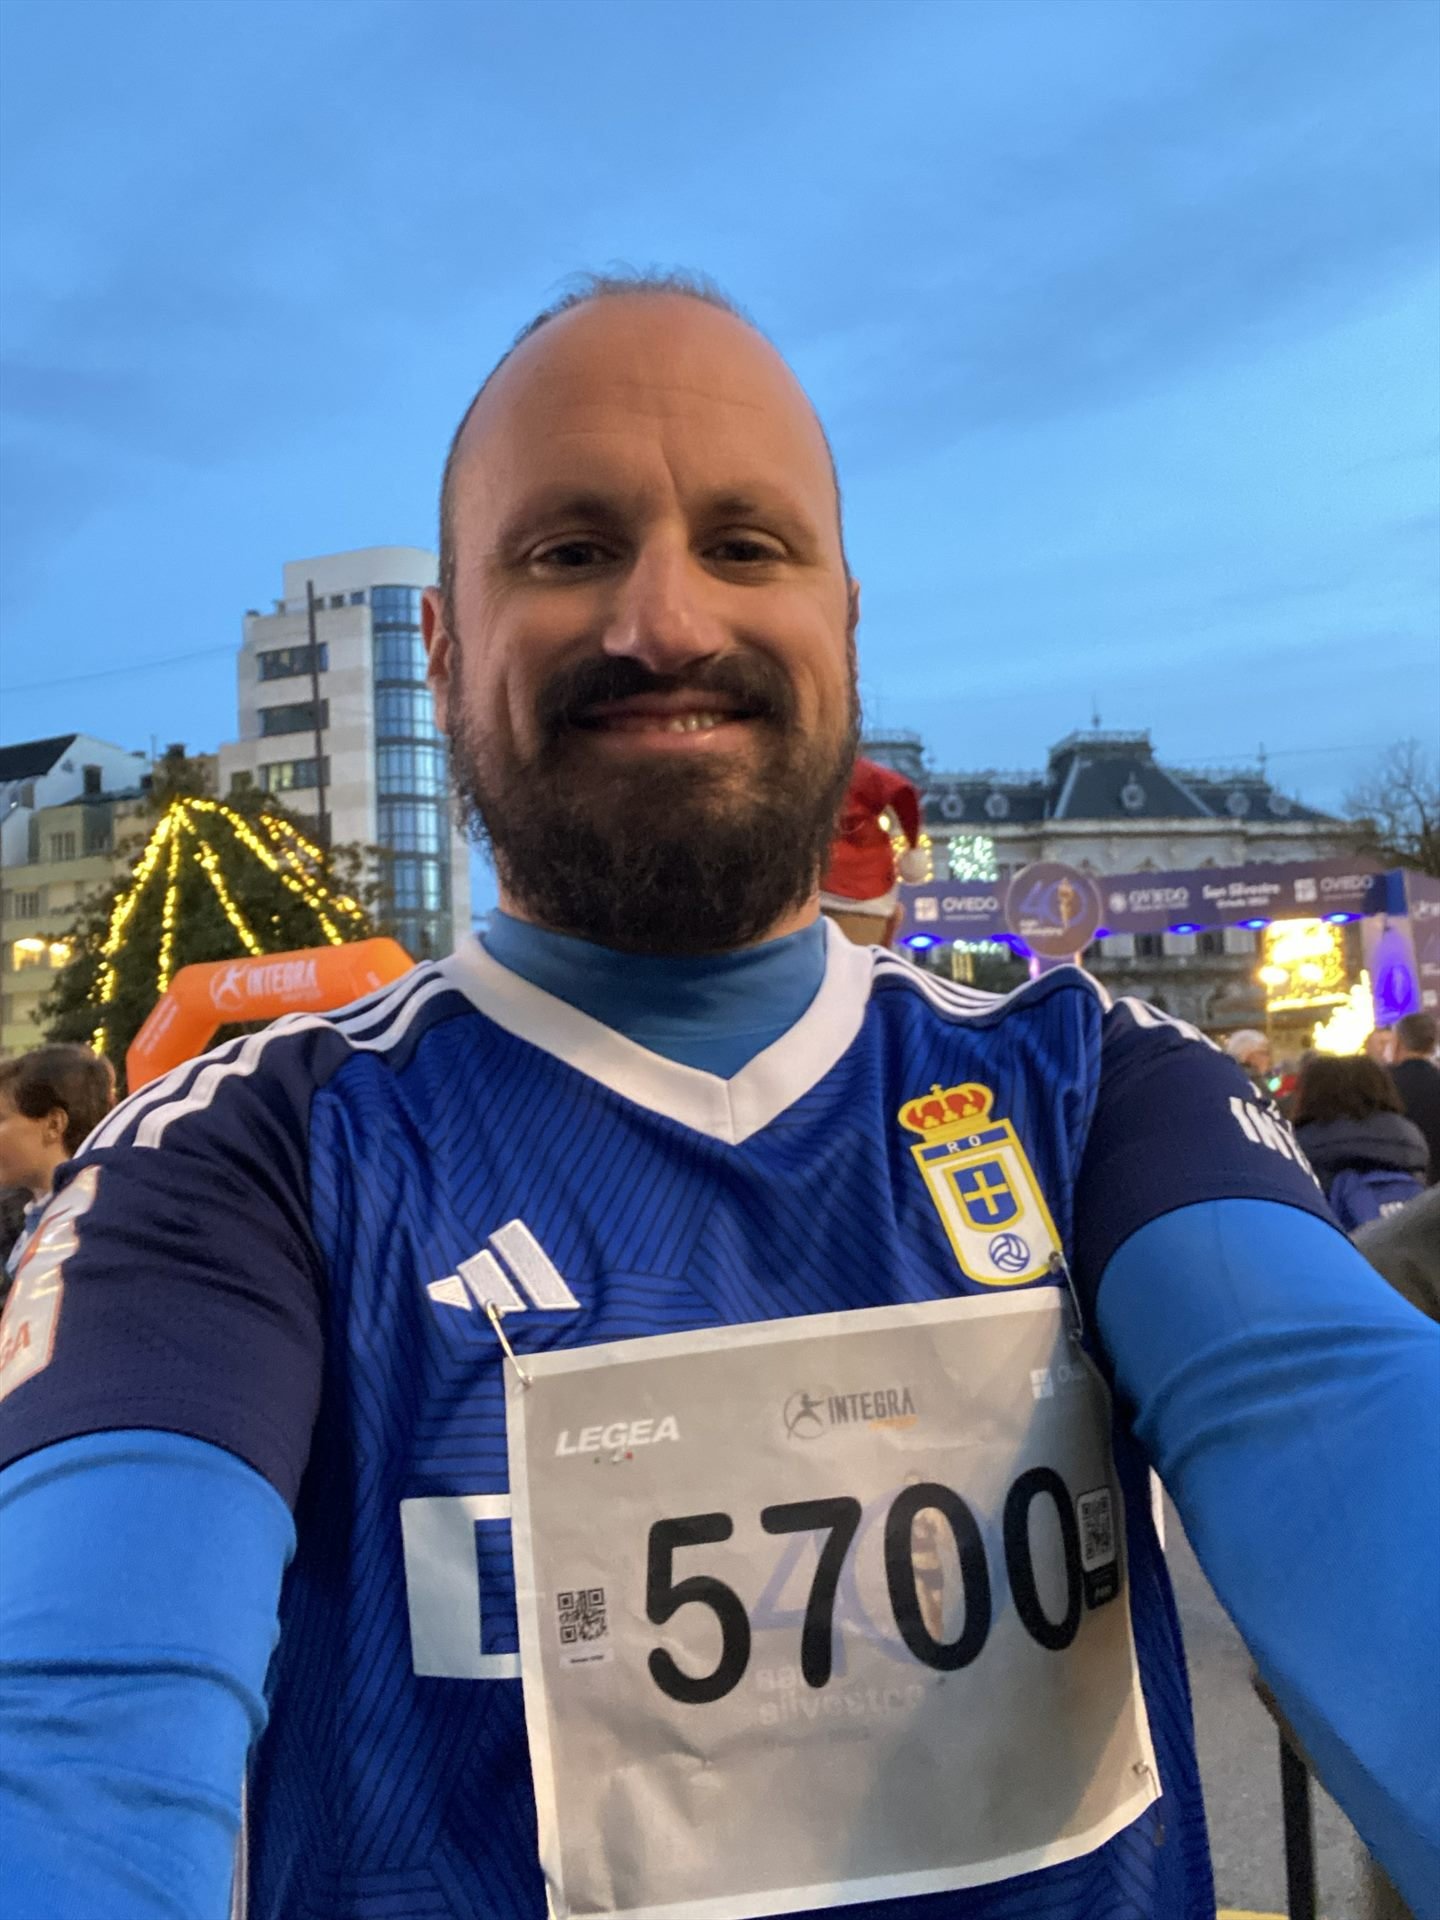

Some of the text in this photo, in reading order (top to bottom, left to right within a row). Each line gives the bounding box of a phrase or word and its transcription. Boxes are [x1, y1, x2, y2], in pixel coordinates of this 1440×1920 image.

[1128, 887, 1189, 905] OVIEDO
[1320, 874, 1374, 892] OVIEDO
[942, 896, 999, 912] OVIEDO
[246, 960, 318, 996] INTEGRA
[827, 1386, 915, 1425] INTEGRA
[554, 1415, 681, 1456] LEGEA
[646, 1466, 1083, 1704] 5700
